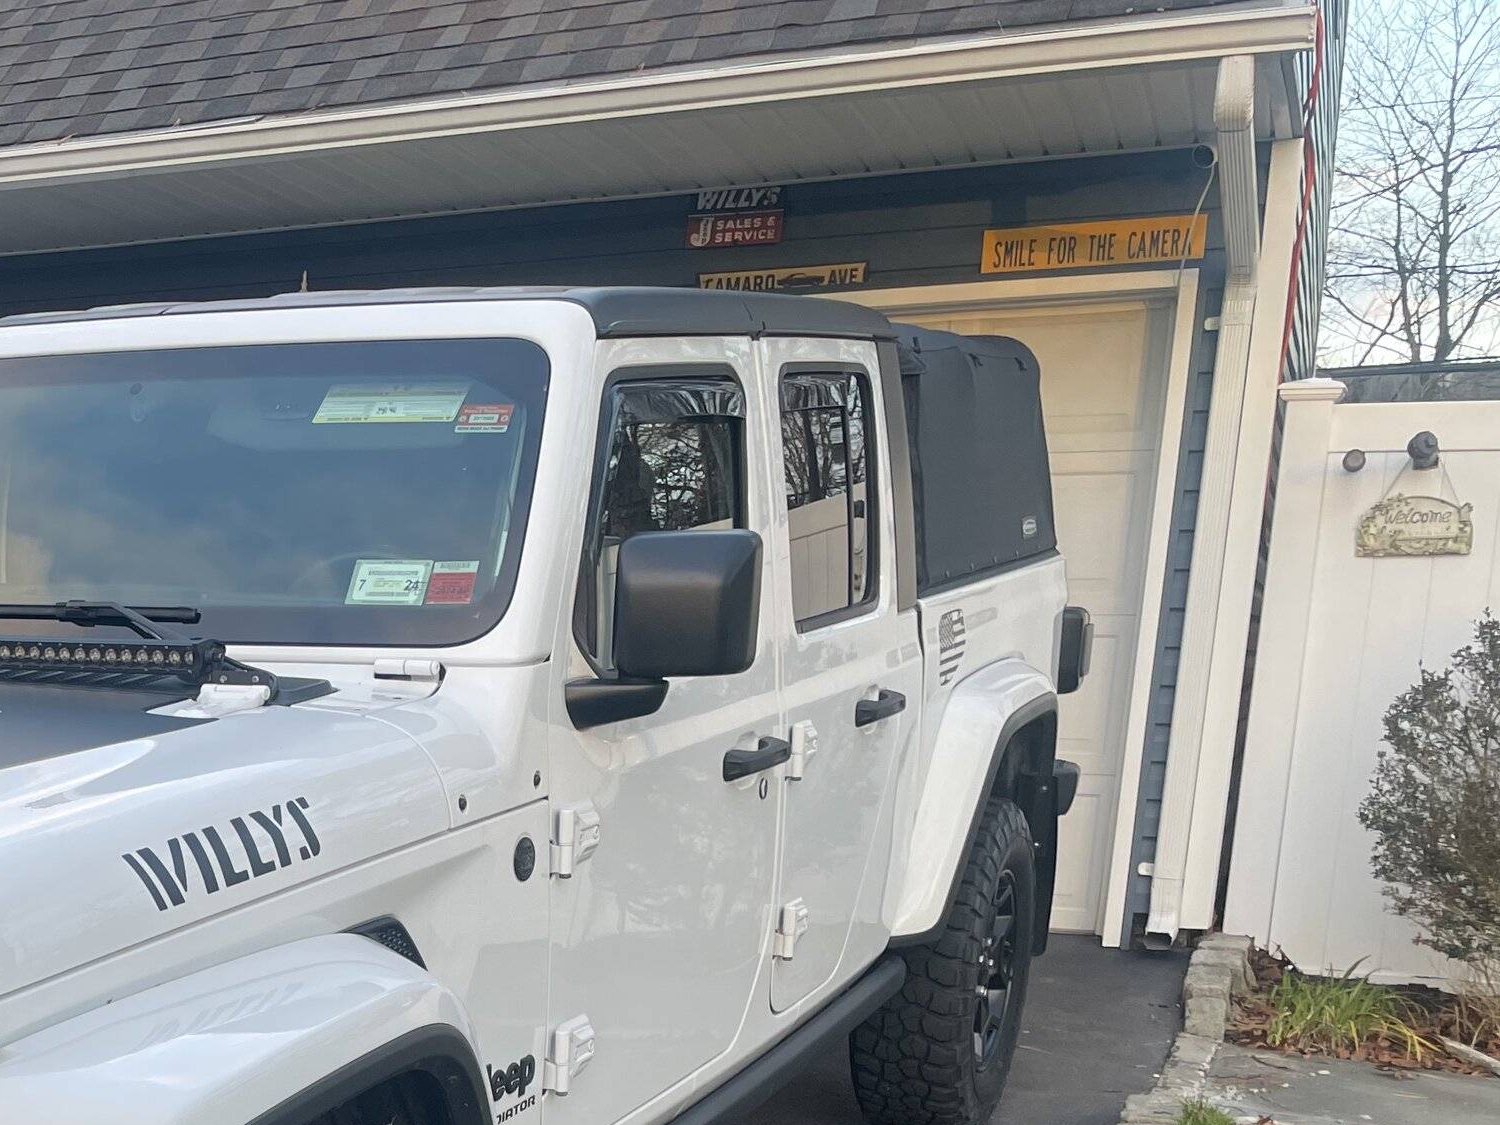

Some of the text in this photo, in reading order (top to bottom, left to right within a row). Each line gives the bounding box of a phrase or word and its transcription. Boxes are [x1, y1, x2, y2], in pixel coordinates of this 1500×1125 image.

[716, 216, 776, 230] SALES &
[714, 229, 776, 243] SERVICE
[993, 228, 1192, 268] SMILE FOR THE CAMERA
[828, 268, 859, 285] AVE
[1384, 507, 1452, 525] Welcome
[121, 797, 321, 911] WILLYS
